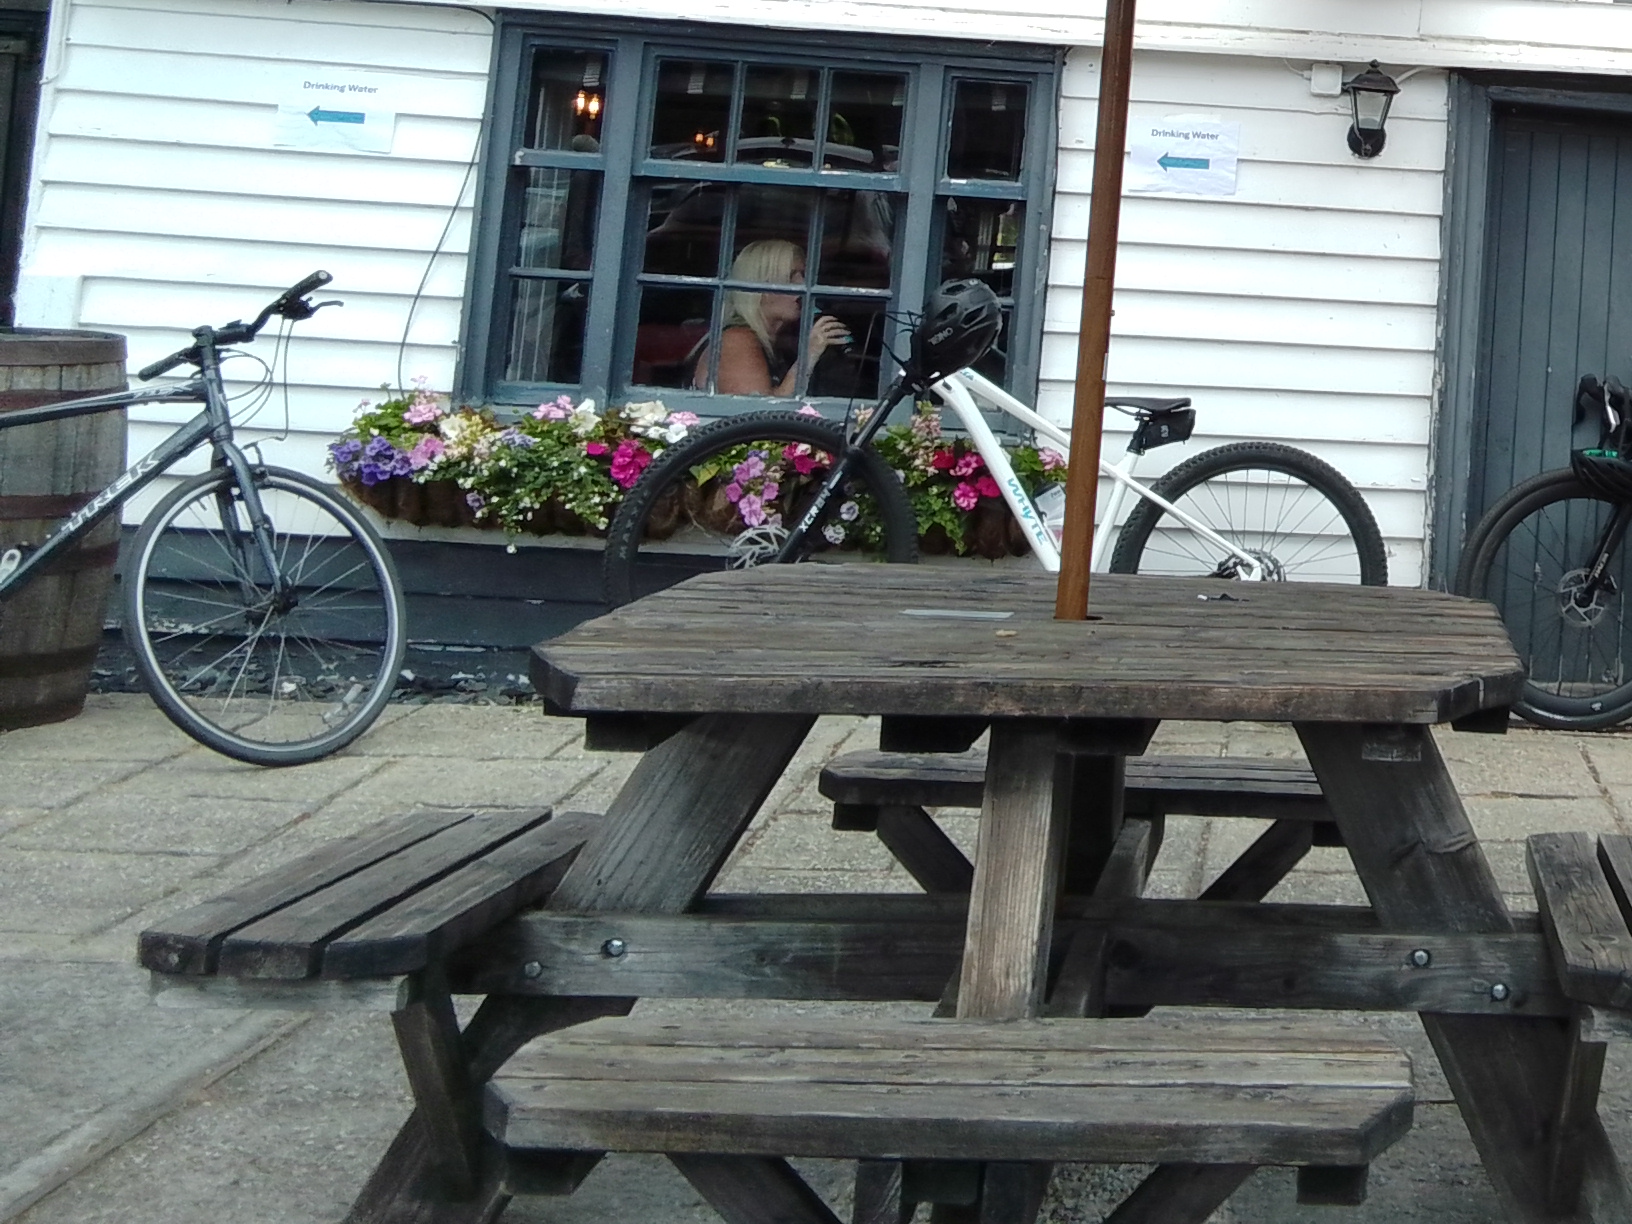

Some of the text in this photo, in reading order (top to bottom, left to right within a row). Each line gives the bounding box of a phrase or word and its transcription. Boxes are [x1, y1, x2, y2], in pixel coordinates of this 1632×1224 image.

[303, 80, 379, 94] Drinking Water
[1151, 128, 1220, 141] Drinking Water
[60, 453, 160, 532] TREK
[1007, 477, 1048, 545] WHYTE
